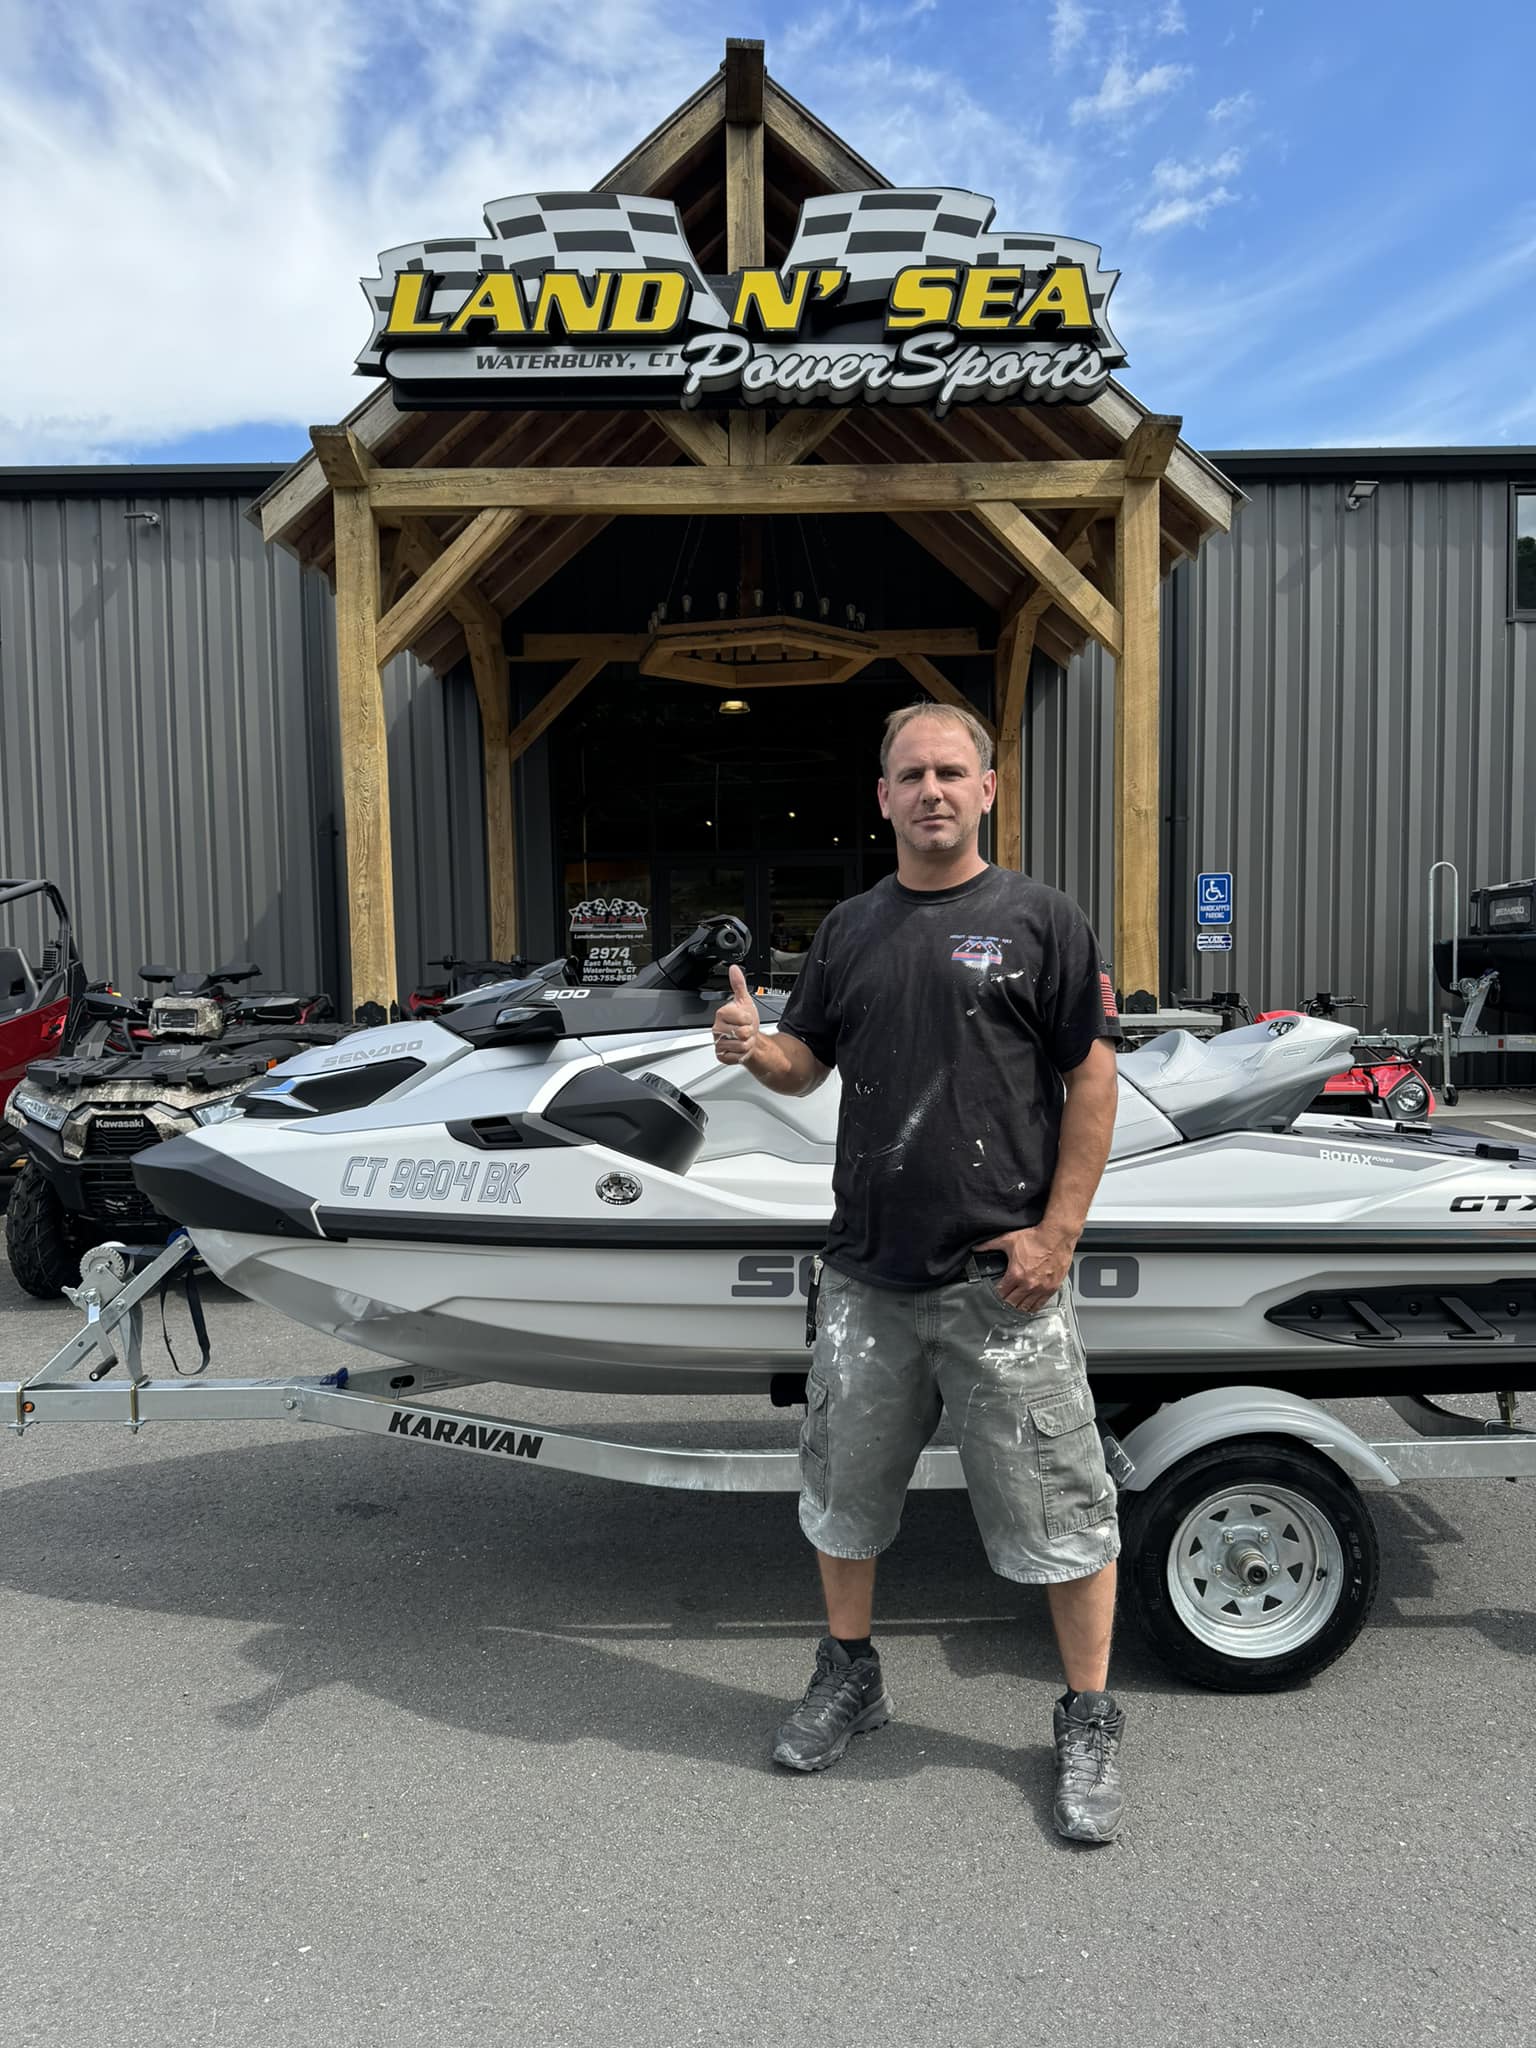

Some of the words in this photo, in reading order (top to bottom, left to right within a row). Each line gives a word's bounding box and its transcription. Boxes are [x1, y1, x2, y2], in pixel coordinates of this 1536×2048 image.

[385, 271, 688, 335] LAND
[731, 268, 848, 331] N'
[885, 265, 1096, 330] SEA
[475, 352, 637, 370] WATERBURY,
[647, 352, 680, 368] CT
[682, 331, 1109, 409] PowerSports
[589, 946, 630, 960] 2974
[583, 959, 601, 967] East
[602, 959, 622, 967] Main
[625, 966, 637, 974] CT
[541, 989, 591, 1001] 300
[95, 1119, 144, 1129] Kawasaki
[1319, 1149, 1372, 1167] ROTAX
[340, 1156, 388, 1198] CT
[388, 1158, 481, 1202] 9604
[477, 1161, 530, 1204] BK
[388, 1411, 544, 1459] KARAVAN
